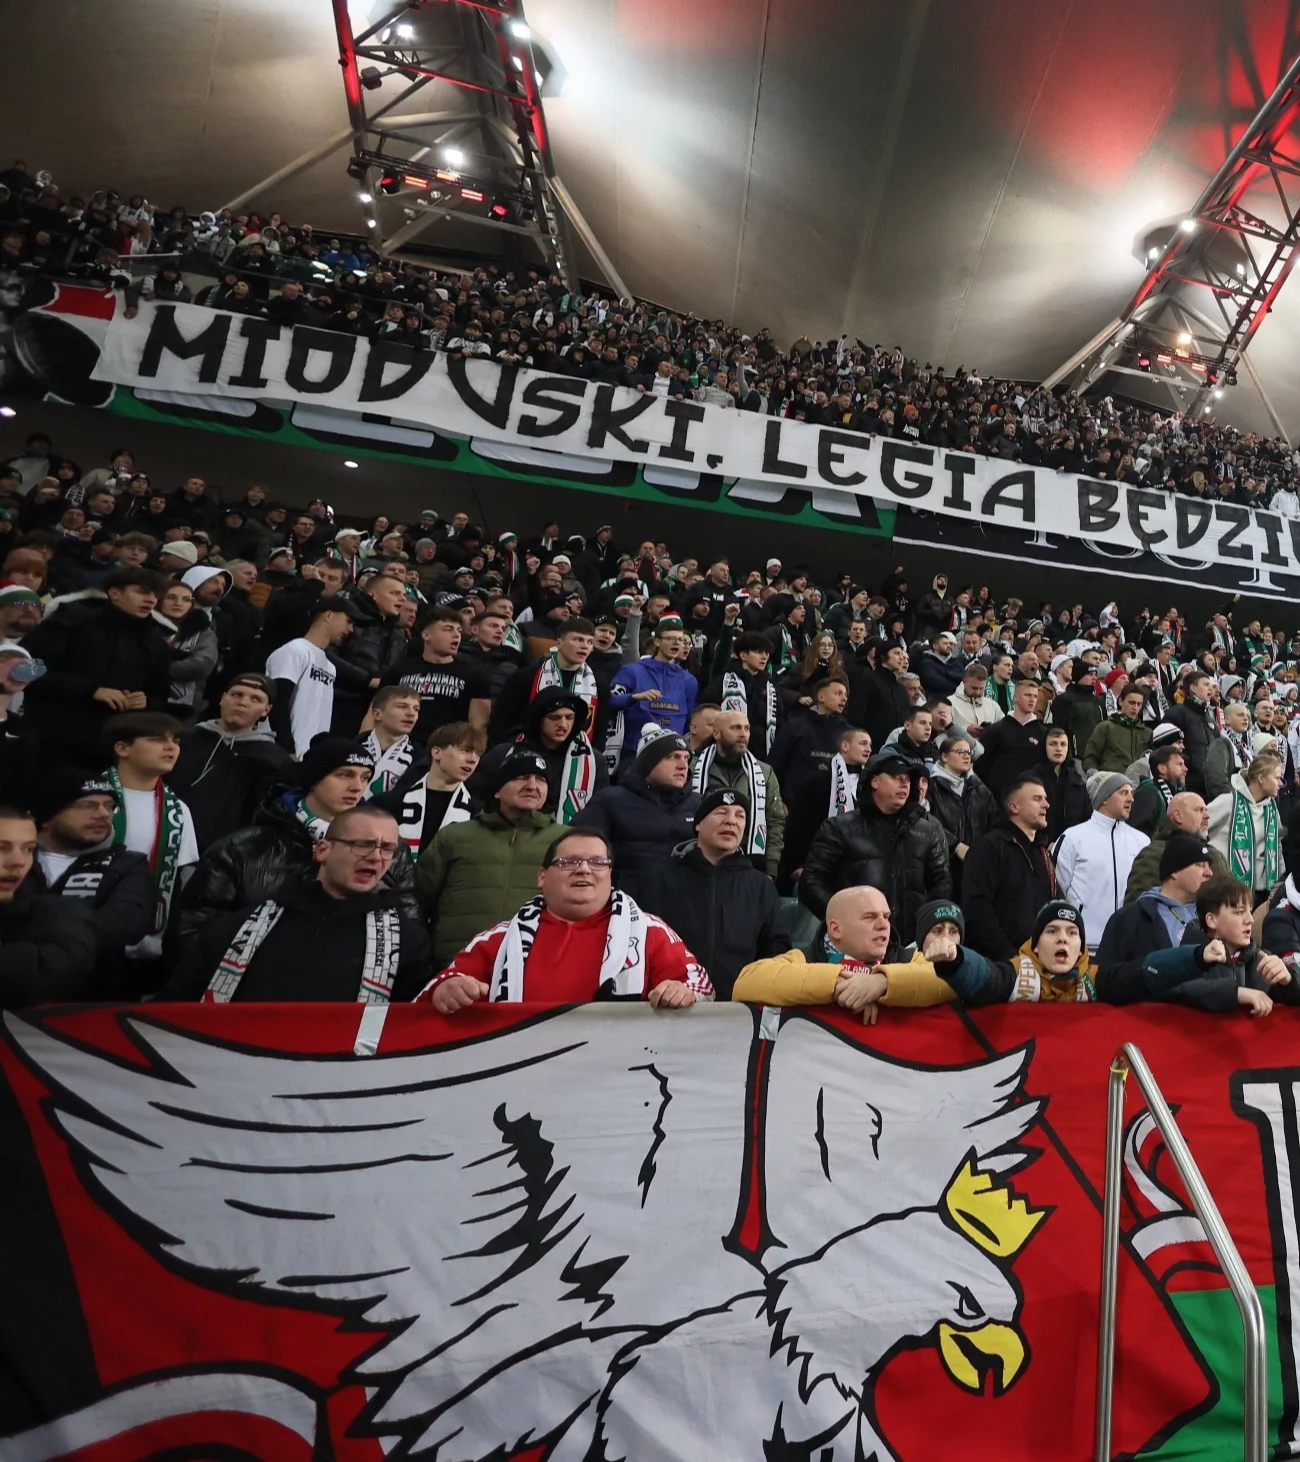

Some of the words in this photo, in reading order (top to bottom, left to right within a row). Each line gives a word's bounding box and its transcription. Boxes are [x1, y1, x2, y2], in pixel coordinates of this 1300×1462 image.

[761, 419, 1036, 524] LEGIA
[425, 672, 465, 690] ANIMALS
[427, 683, 460, 699] ANTIFA
